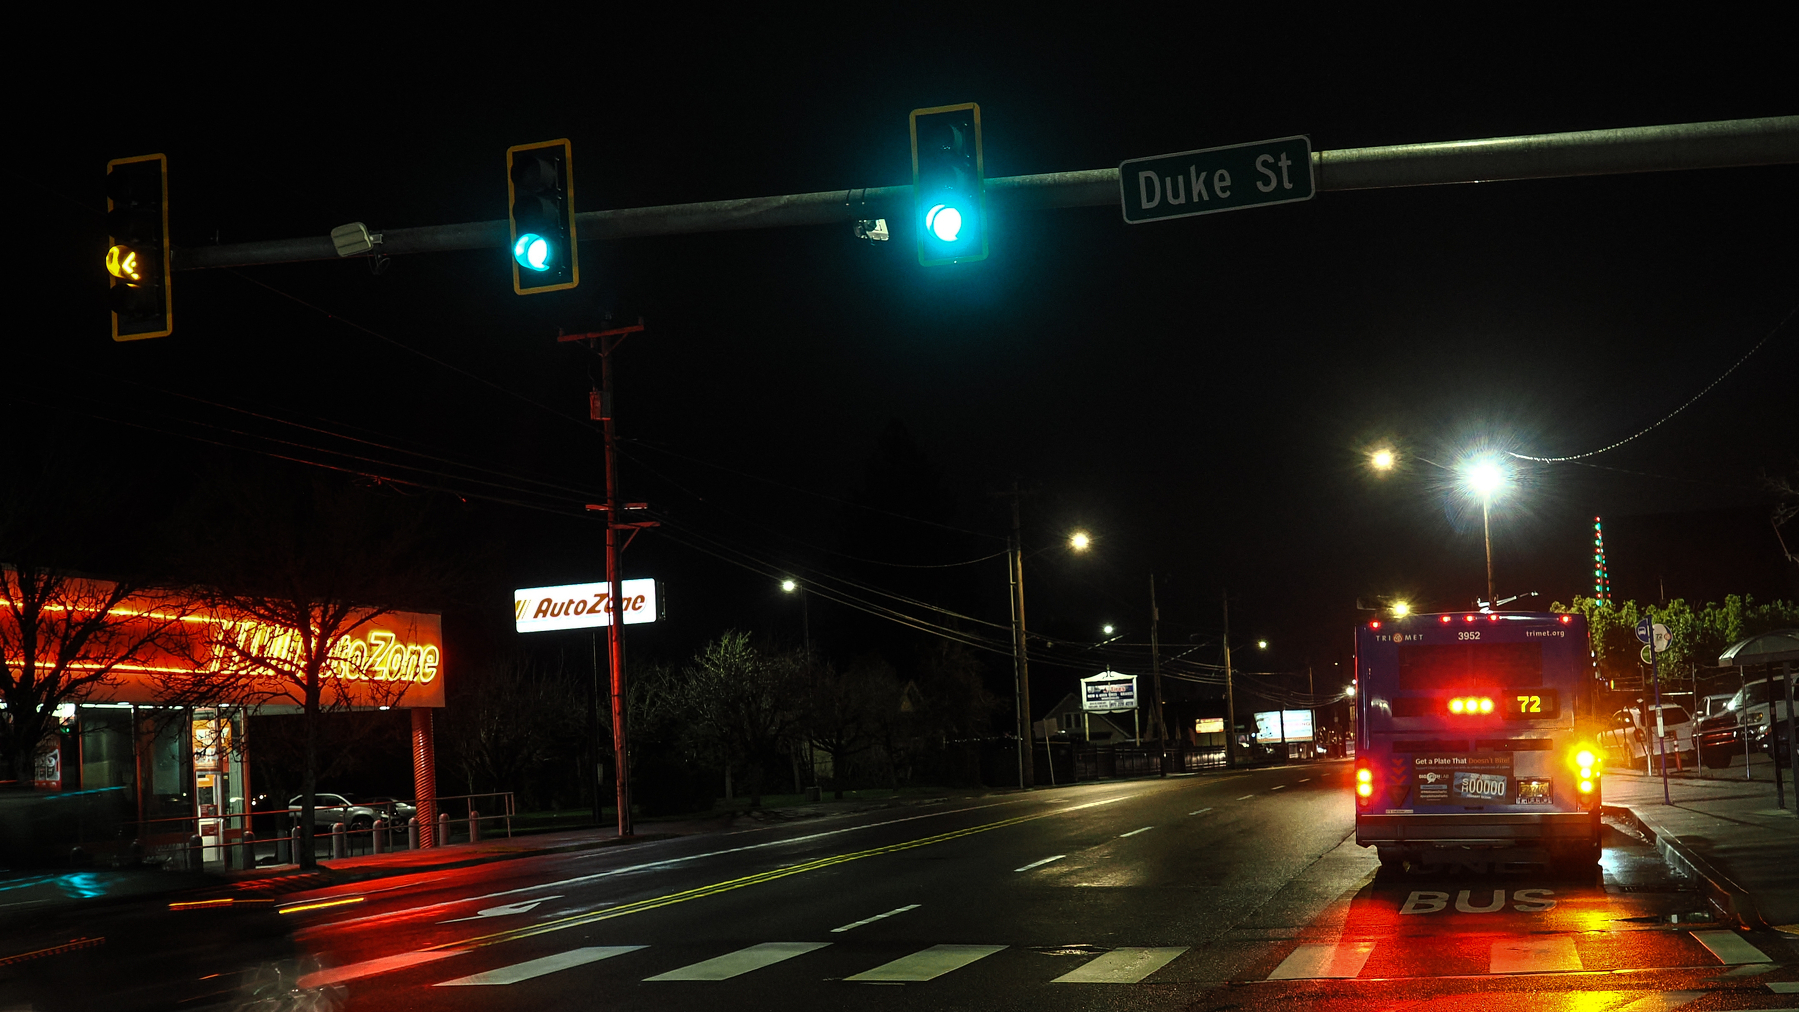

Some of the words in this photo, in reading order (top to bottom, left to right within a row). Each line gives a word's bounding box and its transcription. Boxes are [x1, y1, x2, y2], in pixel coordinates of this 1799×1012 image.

[1138, 164, 1232, 210] Duke
[1255, 151, 1294, 193] St
[1458, 631, 1481, 641] 3952
[1526, 630, 1565, 638] trimet.org
[1516, 695, 1541, 713] 72
[1469, 779, 1505, 796] 00000
[1399, 889, 1557, 915] BUS
